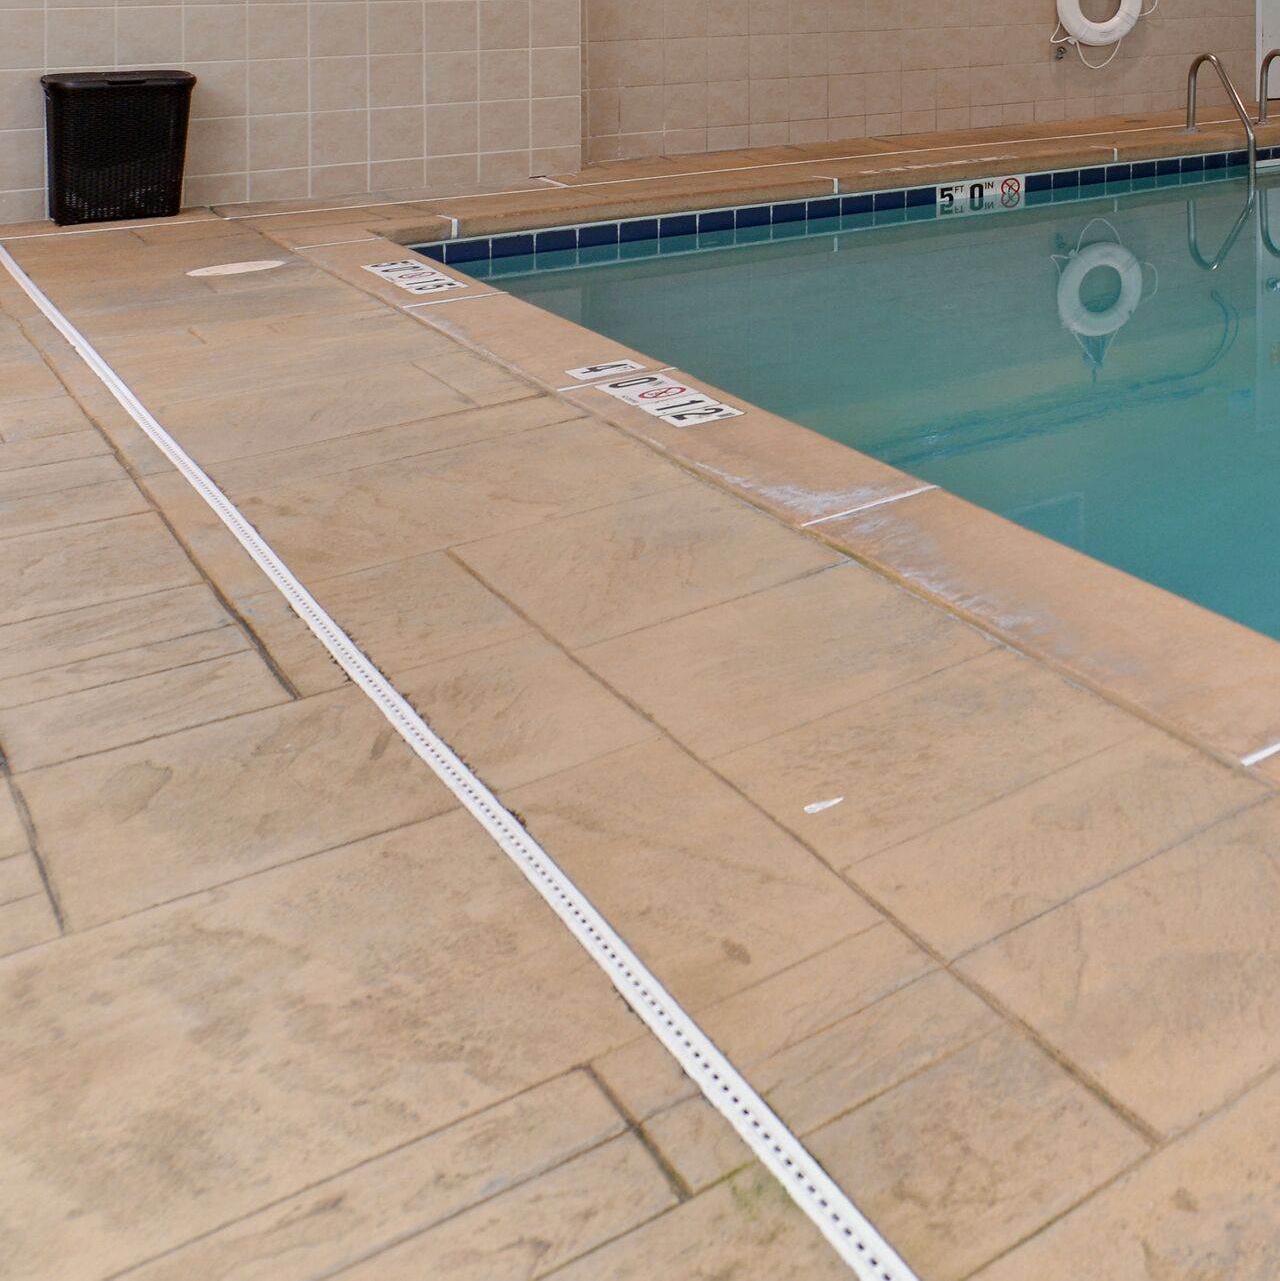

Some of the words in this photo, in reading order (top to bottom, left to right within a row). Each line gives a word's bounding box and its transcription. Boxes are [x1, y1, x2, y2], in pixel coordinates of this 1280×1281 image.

[940, 187, 954, 201] 5
[954, 185, 964, 194] FT
[984, 181, 994, 189] IN
[580, 362, 629, 375] 4
[608, 376, 658, 389] 0
